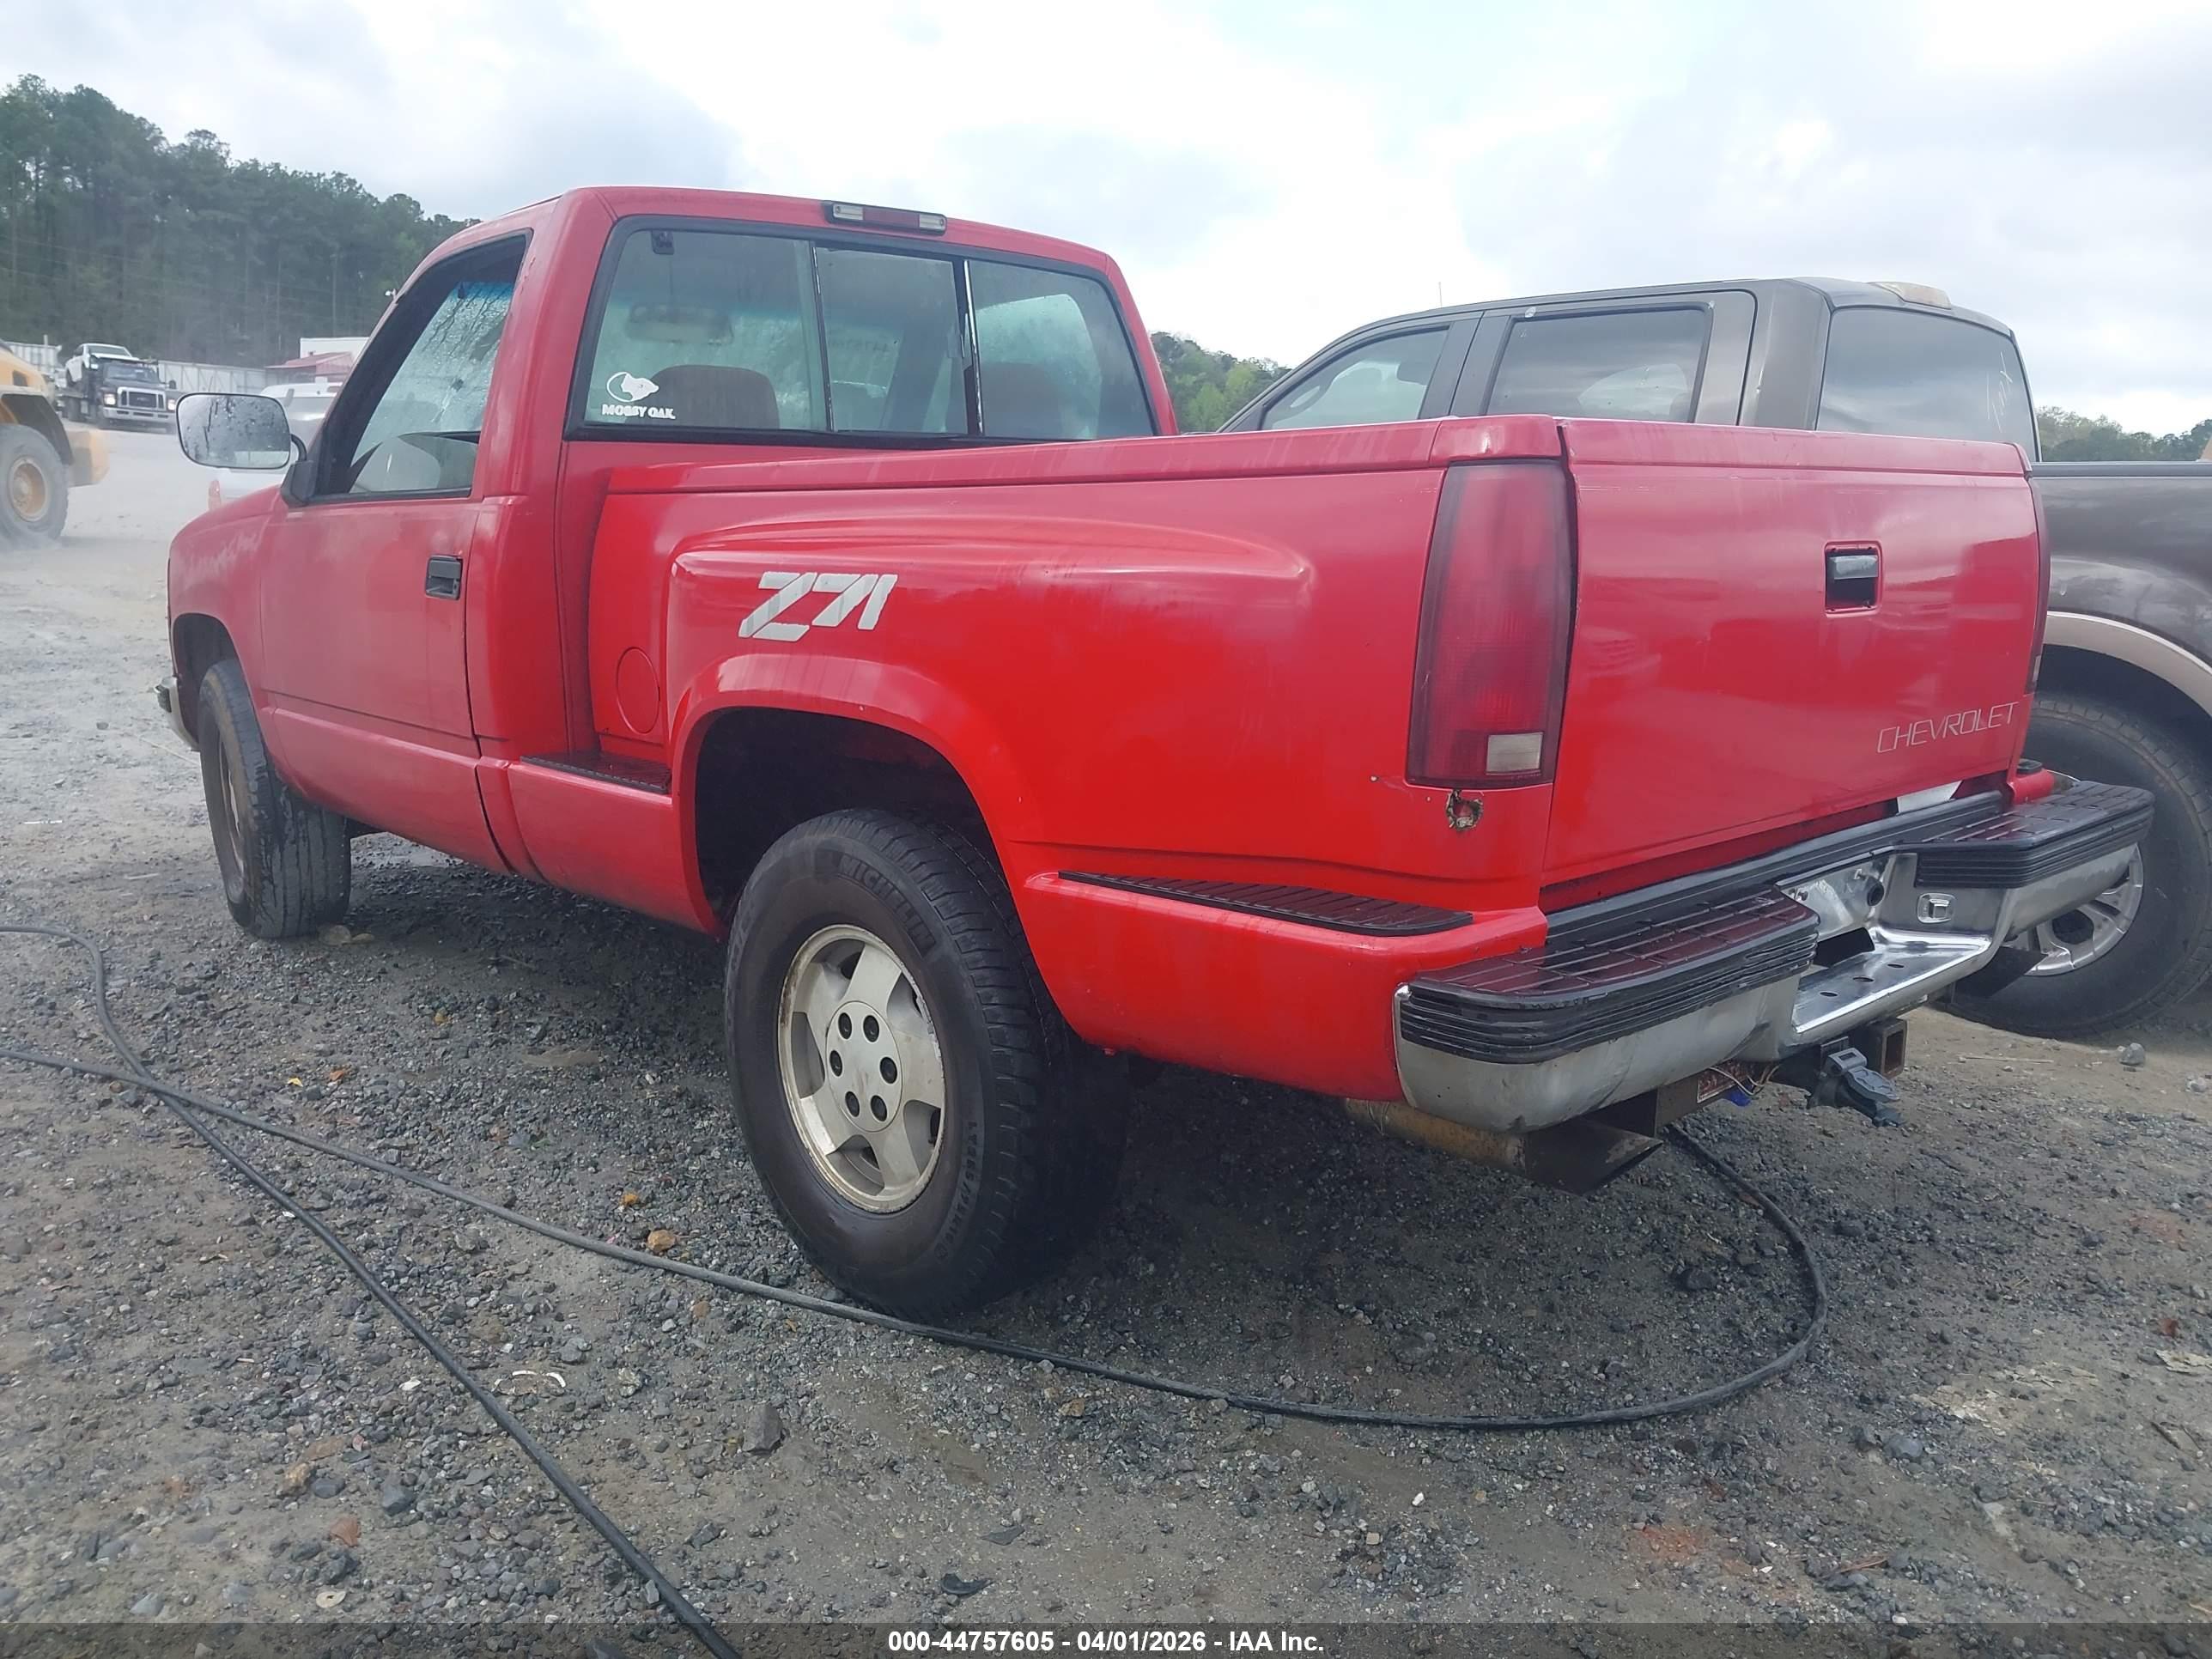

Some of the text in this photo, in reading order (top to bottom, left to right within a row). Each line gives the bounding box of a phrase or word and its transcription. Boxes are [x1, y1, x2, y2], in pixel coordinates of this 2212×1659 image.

[738, 571, 898, 642] Z71
[1877, 701, 2020, 753] CHEVROLET
[838, 852, 936, 944] MICHELIN
